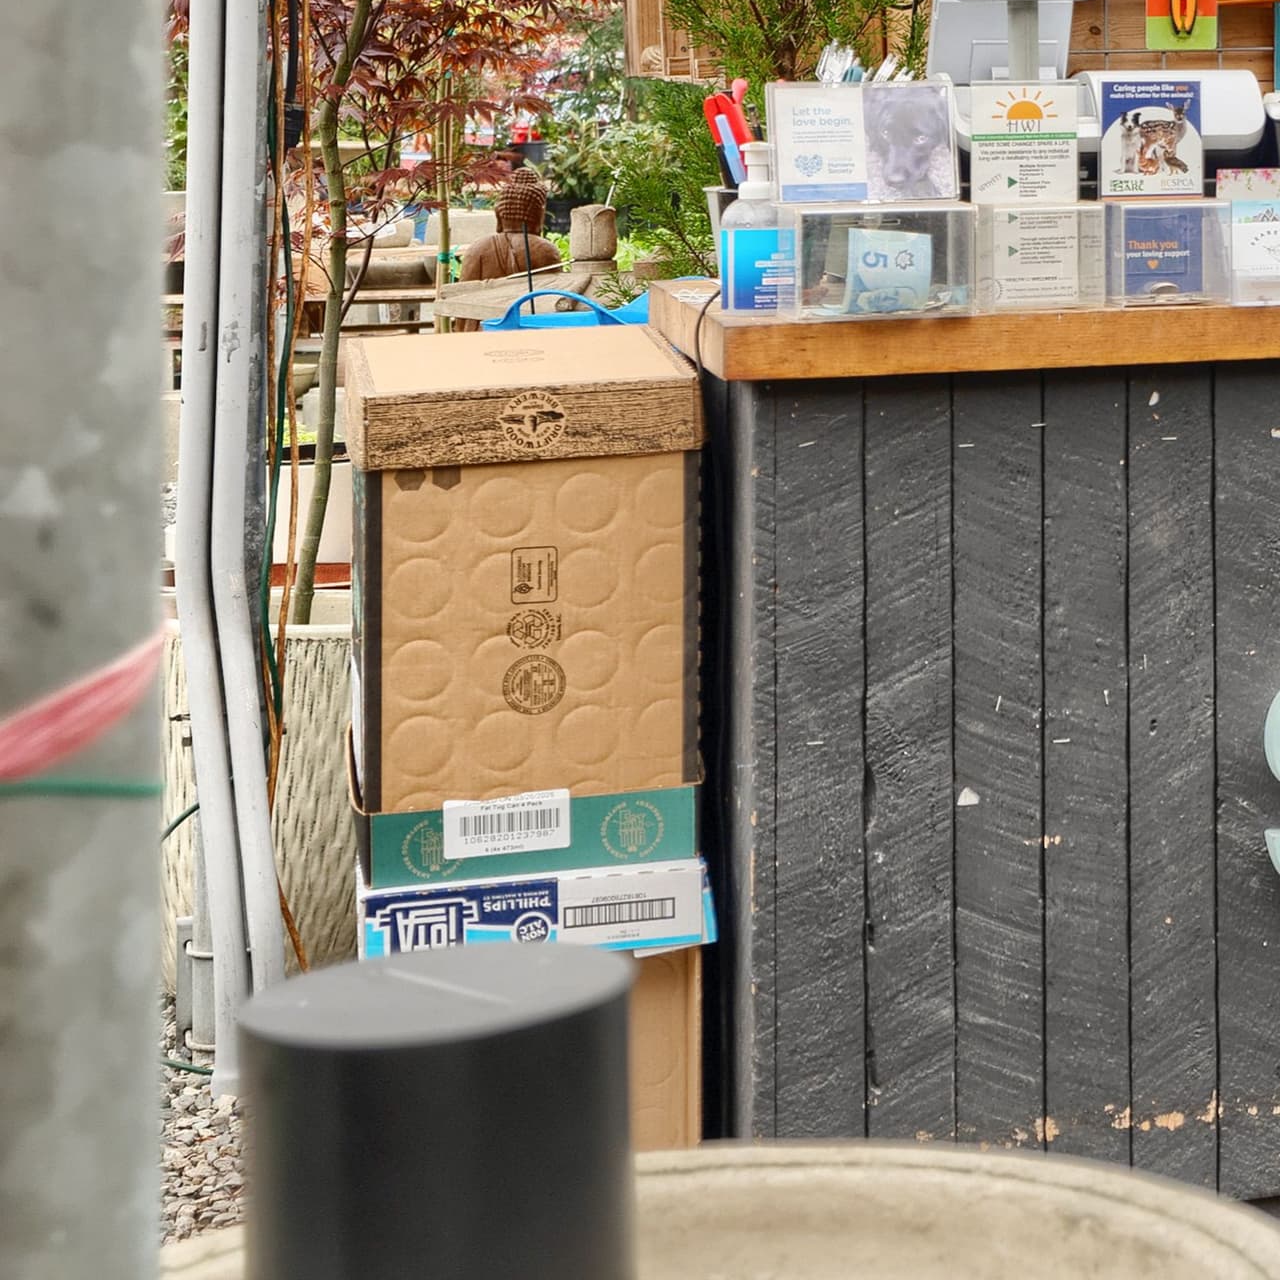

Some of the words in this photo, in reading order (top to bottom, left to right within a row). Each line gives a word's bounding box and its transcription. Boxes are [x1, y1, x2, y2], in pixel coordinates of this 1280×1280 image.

[1113, 84, 1136, 93] Caring
[1137, 84, 1160, 93] people
[792, 105, 809, 116] Let
[813, 105, 832, 116] the
[792, 116, 816, 127] love
[819, 116, 853, 129] begin.
[1128, 239, 1159, 250] Thank
[1159, 241, 1179, 251] you
[862, 250, 889, 269] 5
[1126, 251, 1142, 259] your
[1142, 250, 1163, 259] loving
[1164, 249, 1191, 259] support
[509, 393, 559, 412] BREWERY
[505, 423, 562, 449] DRIFTWOOD
[483, 895, 552, 915] PHILLIPS
[519, 919, 543, 935] ALC
[521, 927, 547, 944] NON
